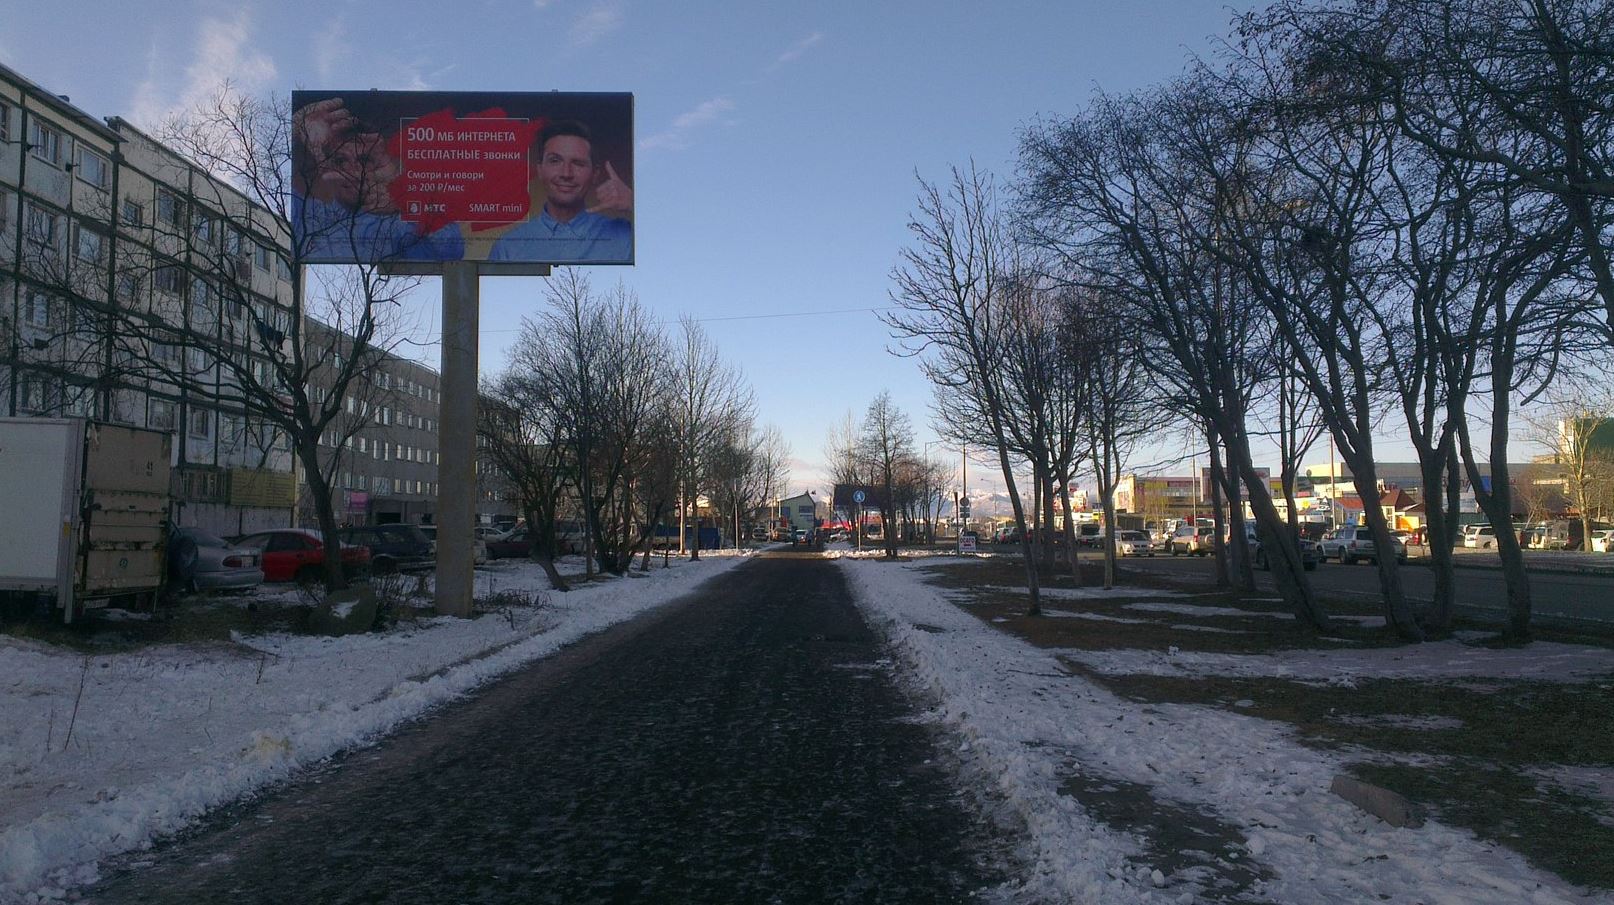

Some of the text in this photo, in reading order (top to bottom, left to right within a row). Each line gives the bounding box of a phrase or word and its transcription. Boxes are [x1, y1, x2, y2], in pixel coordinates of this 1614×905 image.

[407, 127, 516, 142] 500 МБ ИНТЕРНЕТА
[407, 149, 520, 160] БЕСПЛАТНЫЕ звонки
[407, 170, 442, 181] Смотри
[452, 172, 484, 181] говори
[419, 183, 435, 192] 200
[423, 203, 446, 212] МТС
[468, 203, 522, 213] SMART mini
